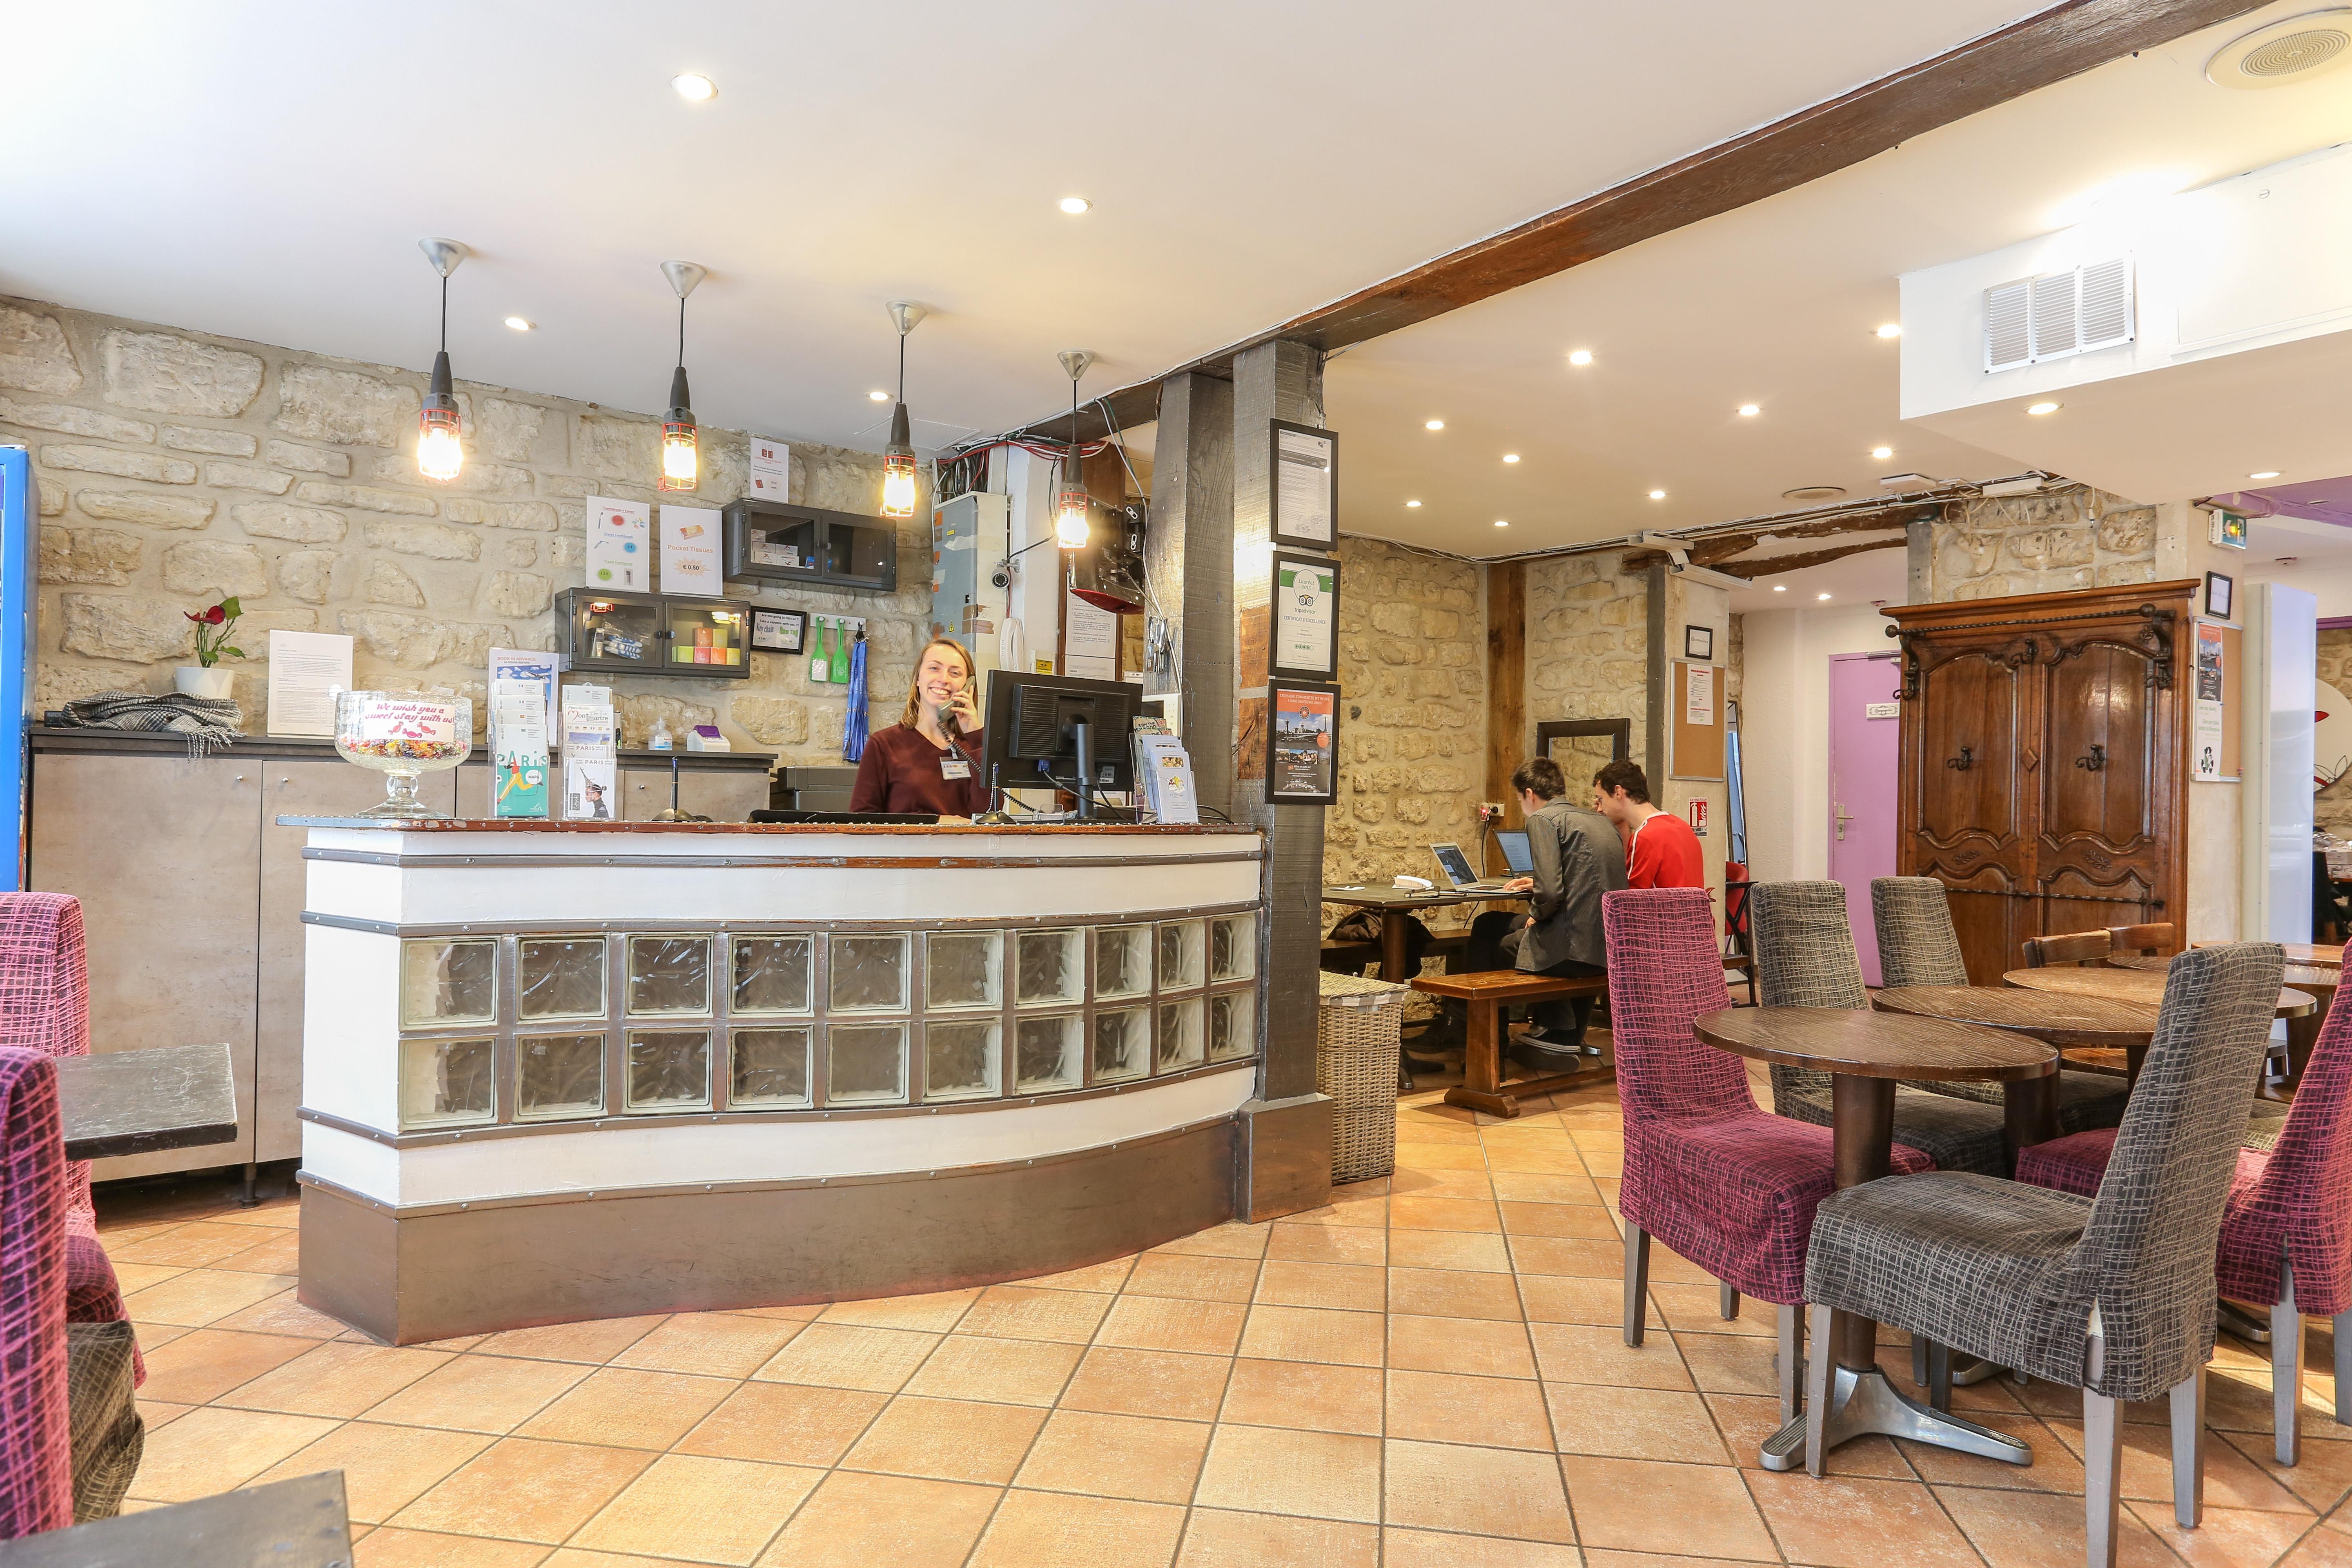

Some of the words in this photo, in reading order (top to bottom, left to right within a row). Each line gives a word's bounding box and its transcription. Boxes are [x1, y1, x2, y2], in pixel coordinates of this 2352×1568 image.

[764, 625, 774, 633] chain
[790, 630, 799, 638] Tag
[416, 706, 437, 715] you
[394, 712, 418, 723] stay
[442, 716, 455, 726] us!
[568, 710, 608, 721] Montmartre
